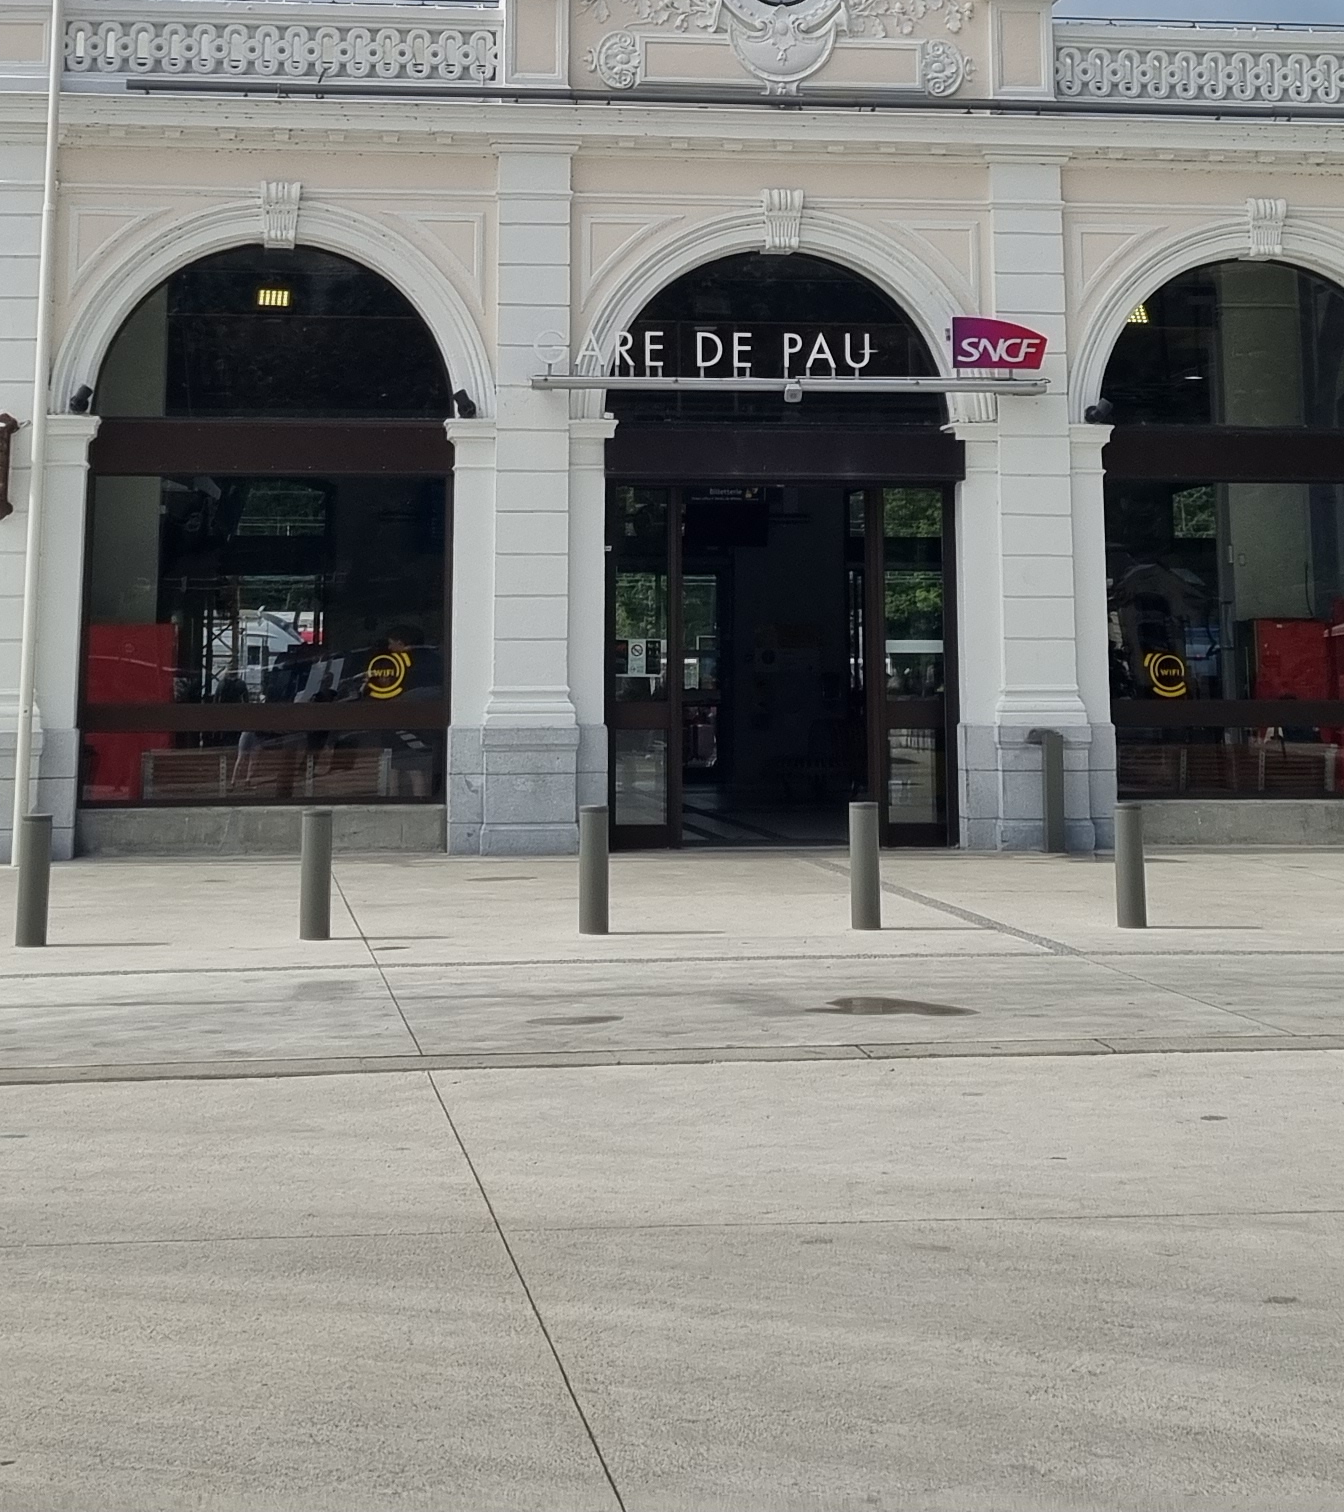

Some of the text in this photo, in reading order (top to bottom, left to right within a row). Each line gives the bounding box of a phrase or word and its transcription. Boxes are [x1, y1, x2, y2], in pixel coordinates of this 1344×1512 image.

[533, 331, 870, 369] GARE DE PAU
[957, 337, 1041, 363] SNCF
